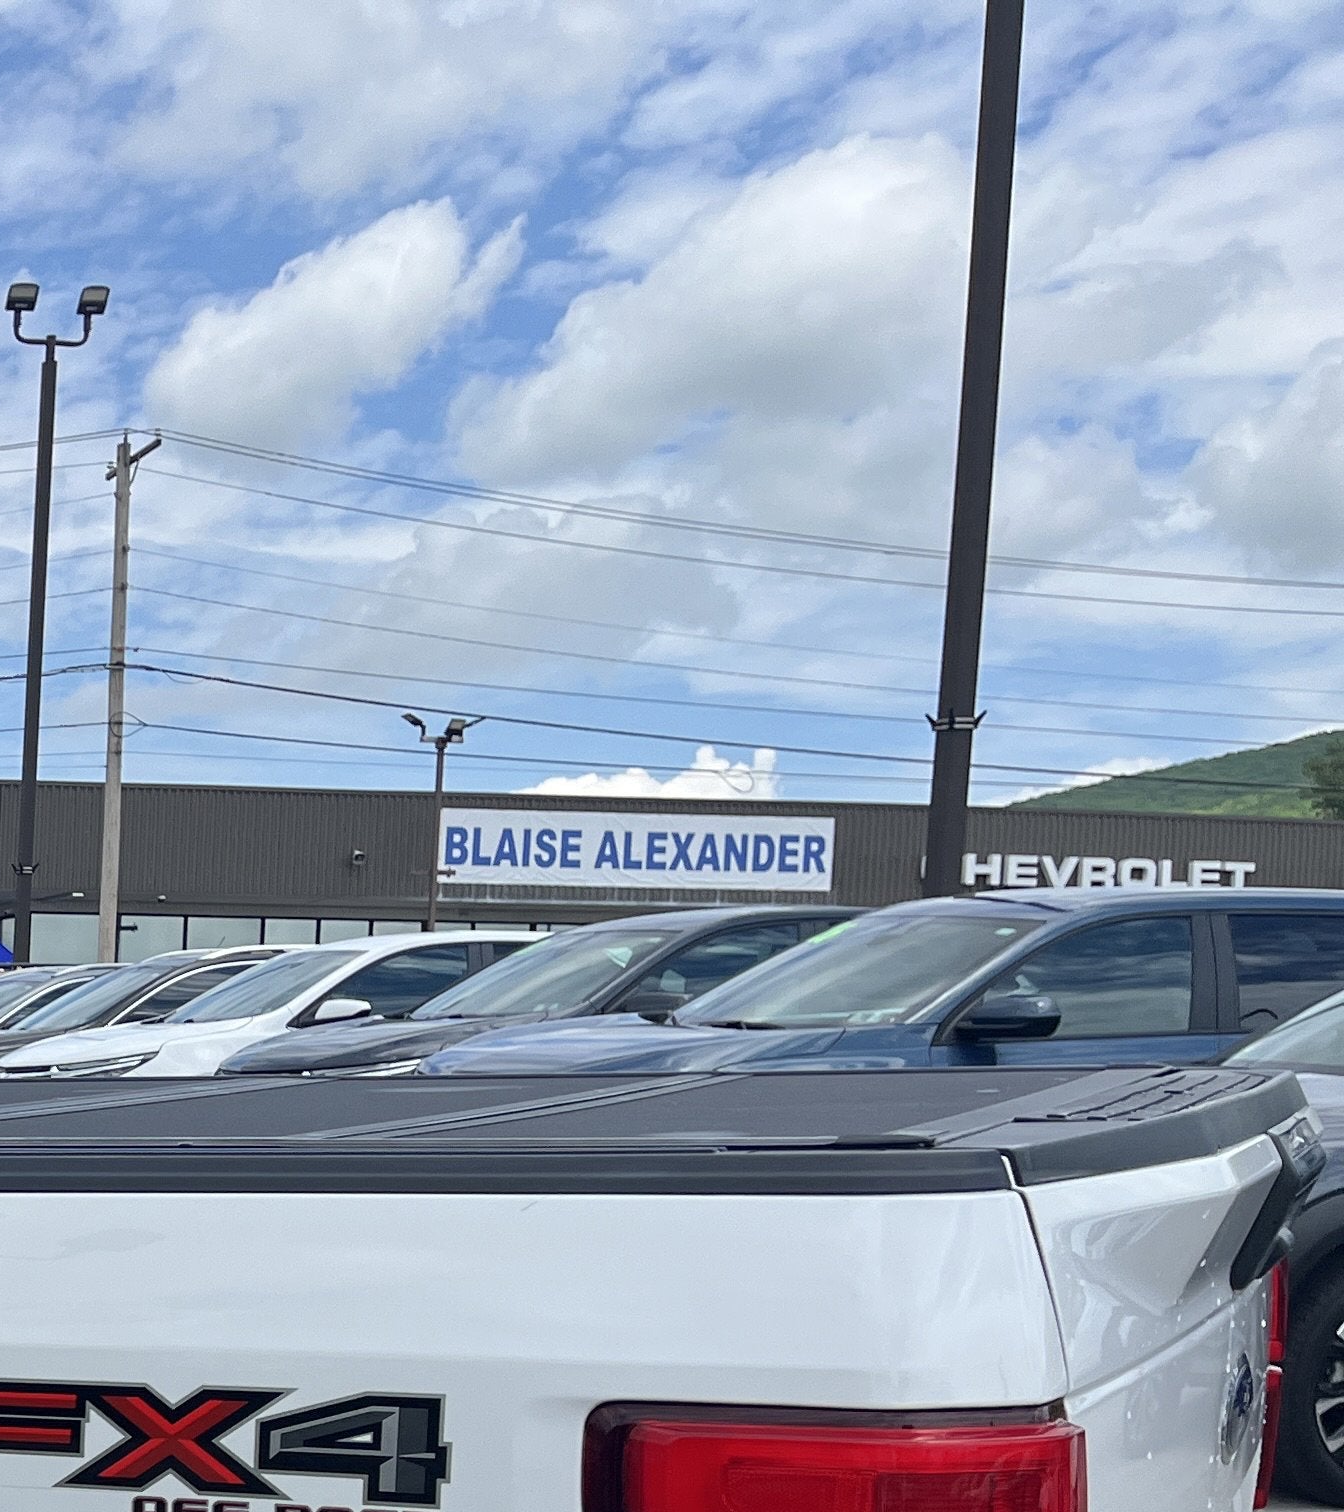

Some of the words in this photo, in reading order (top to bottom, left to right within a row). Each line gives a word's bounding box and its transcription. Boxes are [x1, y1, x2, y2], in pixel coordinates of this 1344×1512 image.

[444, 826, 583, 868] BLAISE
[594, 830, 826, 873] ALEXANDER
[921, 852, 1257, 888] HEVROLET
